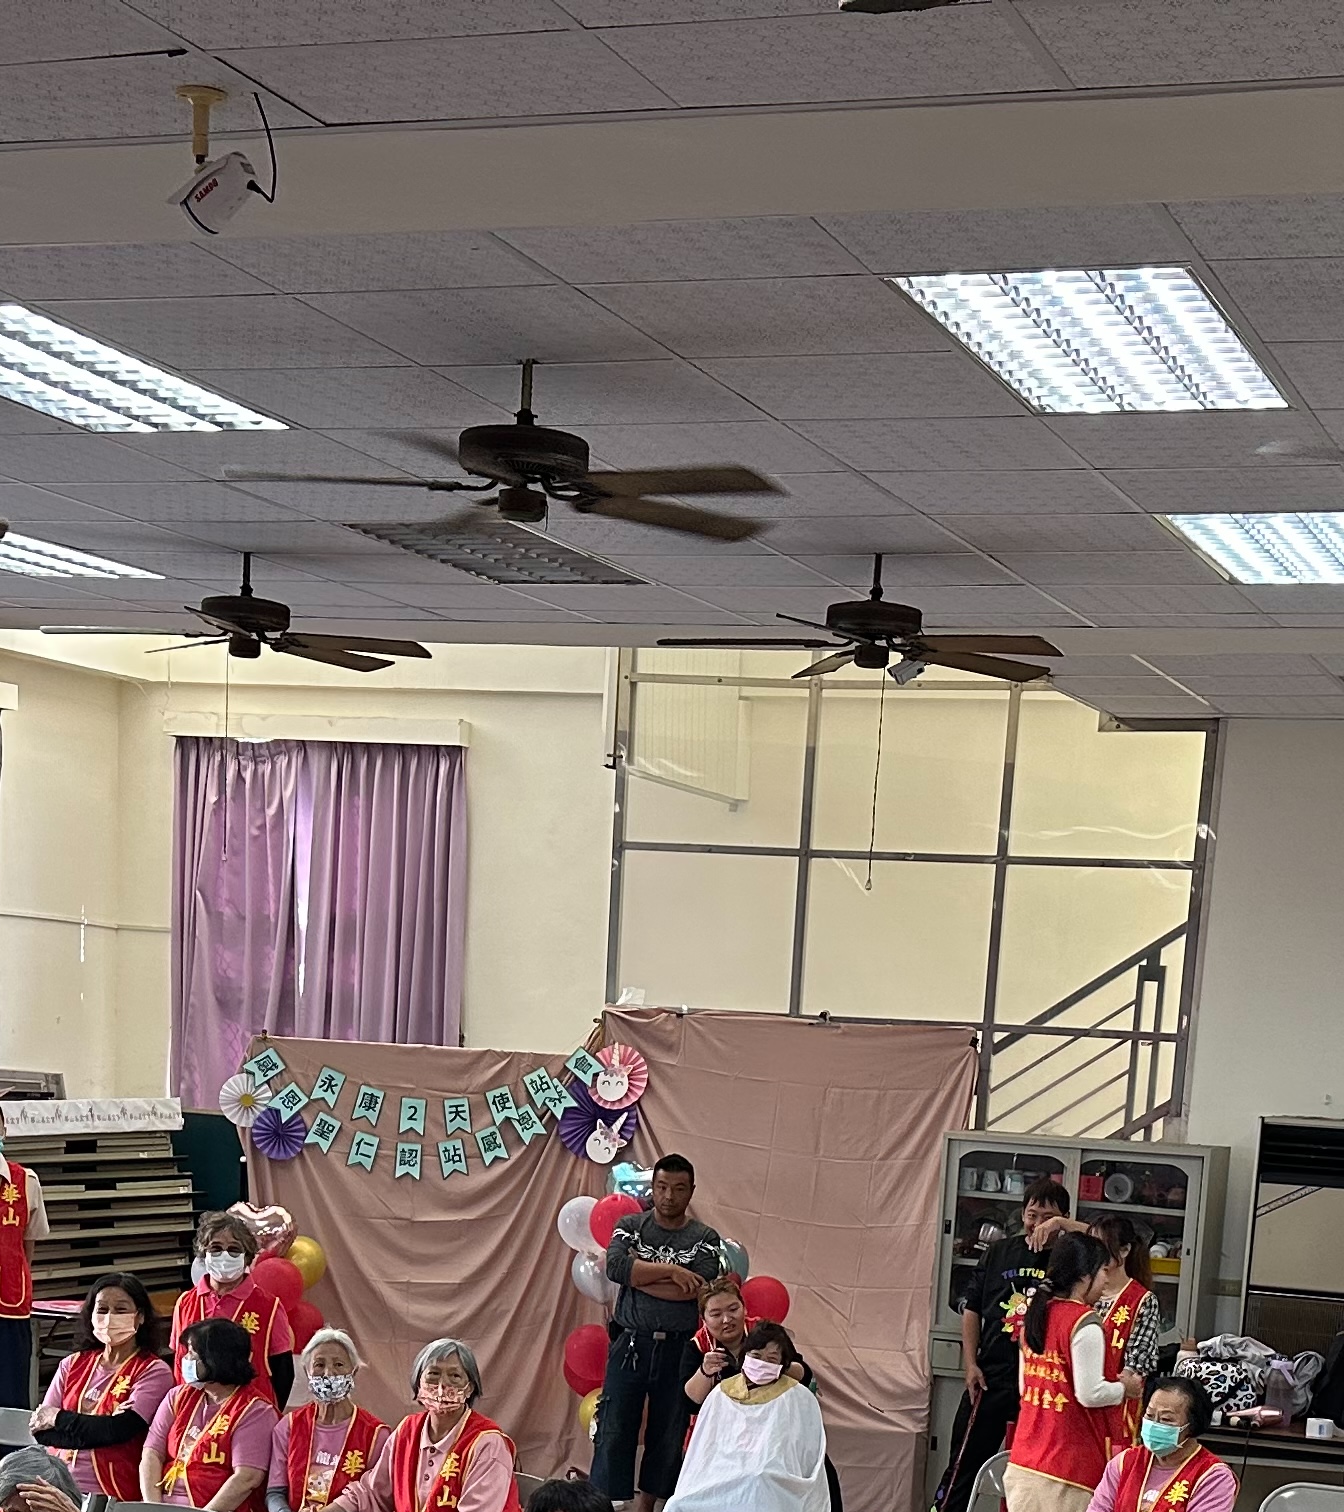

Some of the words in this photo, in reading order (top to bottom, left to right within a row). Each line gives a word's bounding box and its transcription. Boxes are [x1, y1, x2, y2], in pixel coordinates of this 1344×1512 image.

[318, 1073, 551, 1123] 永康2天使站
[1, 1183, 21, 1227] 華山
[203, 1414, 231, 1465] 華山
[341, 1450, 365, 1477] 華
[437, 1452, 460, 1508] 華山
